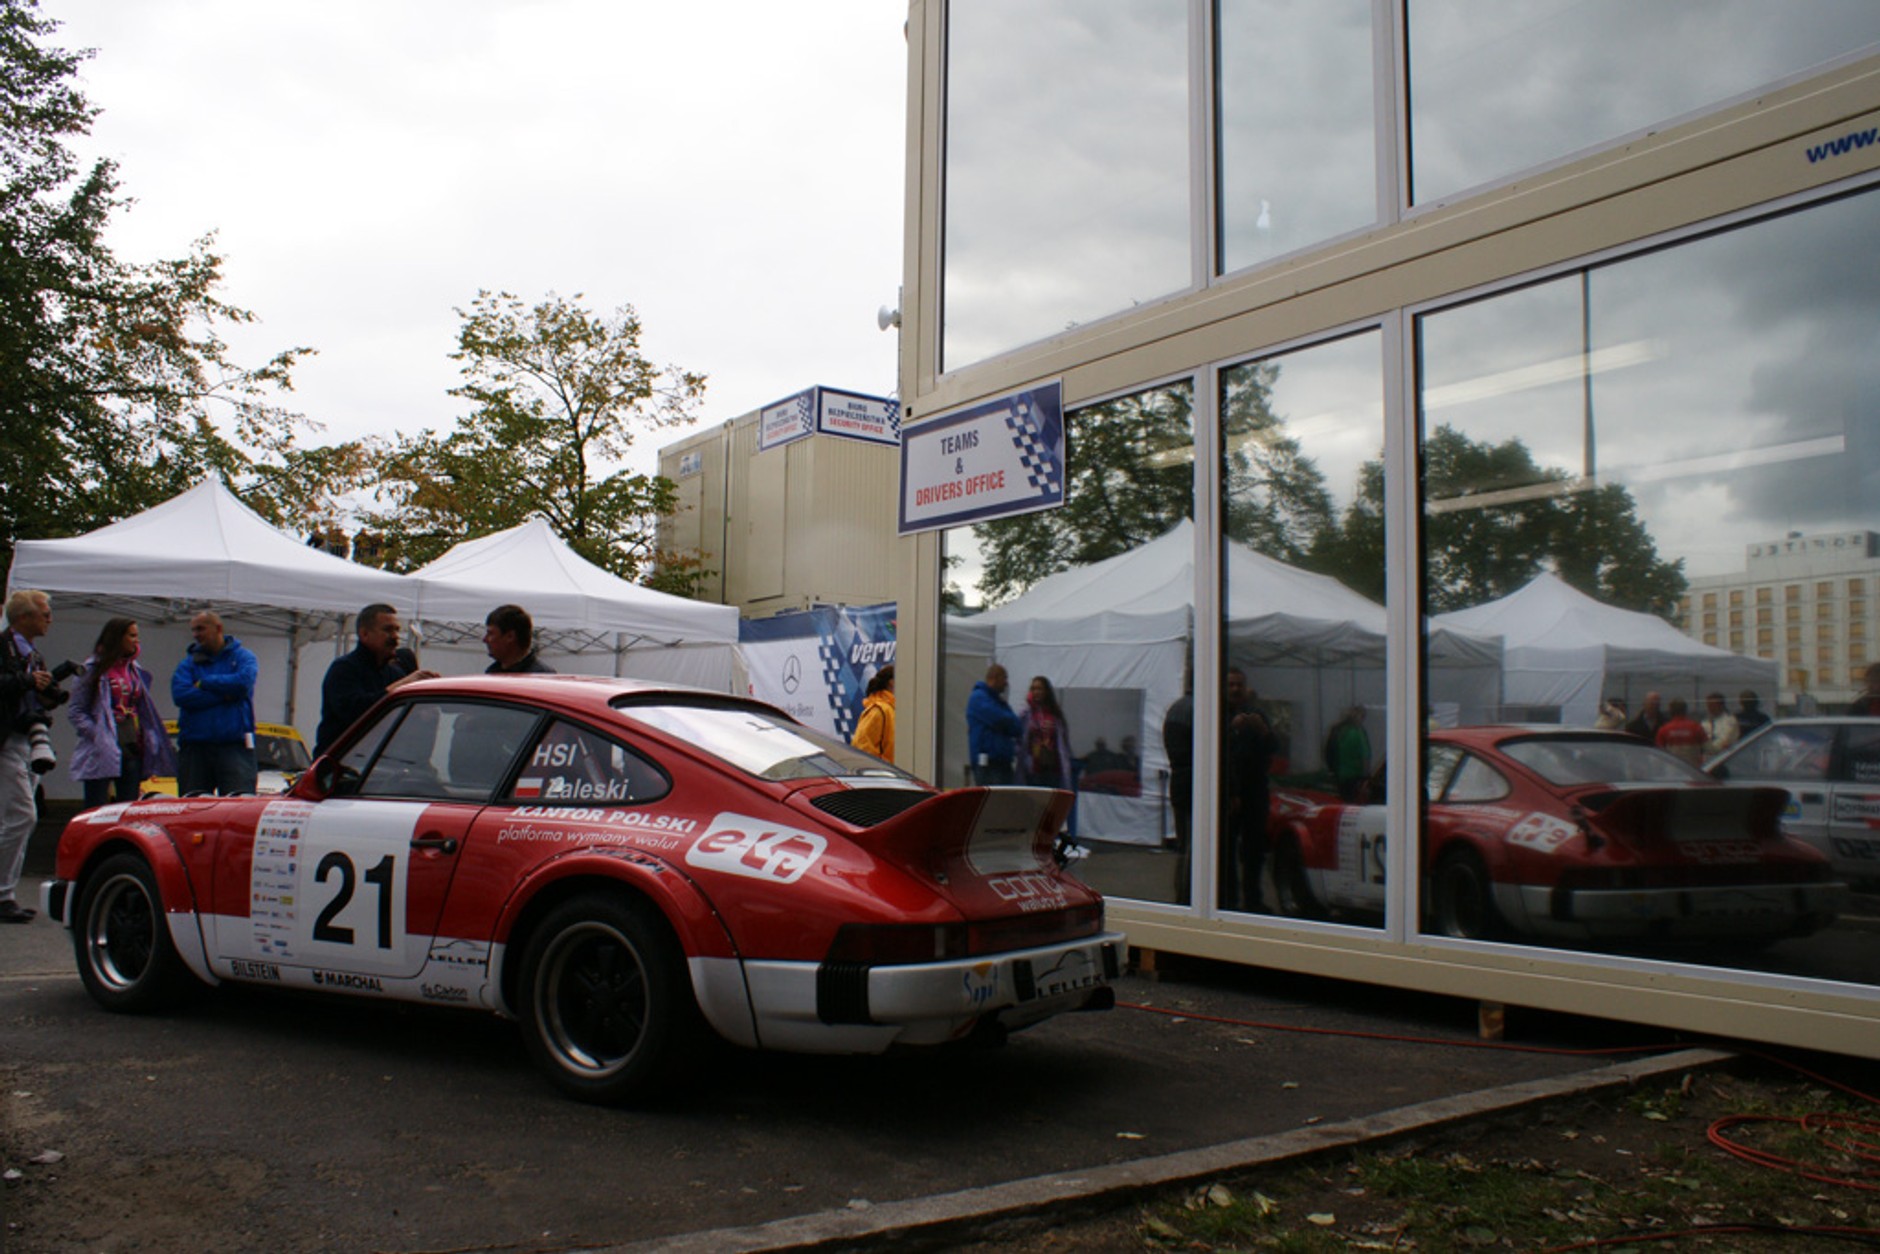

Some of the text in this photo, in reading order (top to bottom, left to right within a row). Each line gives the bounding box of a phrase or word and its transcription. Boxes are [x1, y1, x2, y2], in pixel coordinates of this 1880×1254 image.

[829, 417, 884, 434] SECURITY OFFICE
[940, 429, 979, 456] TEAMS
[955, 457, 964, 475] &
[915, 469, 1005, 507] DRIVERS OFFICE
[851, 641, 897, 665] verv
[532, 744, 578, 767] HSI
[512, 805, 697, 833] KANTOR POLSKI
[497, 824, 680, 850] platforma wymiany walut
[313, 851, 395, 950] 21
[231, 960, 281, 981] BILSTEIN
[325, 971, 383, 992] MARCHAL
